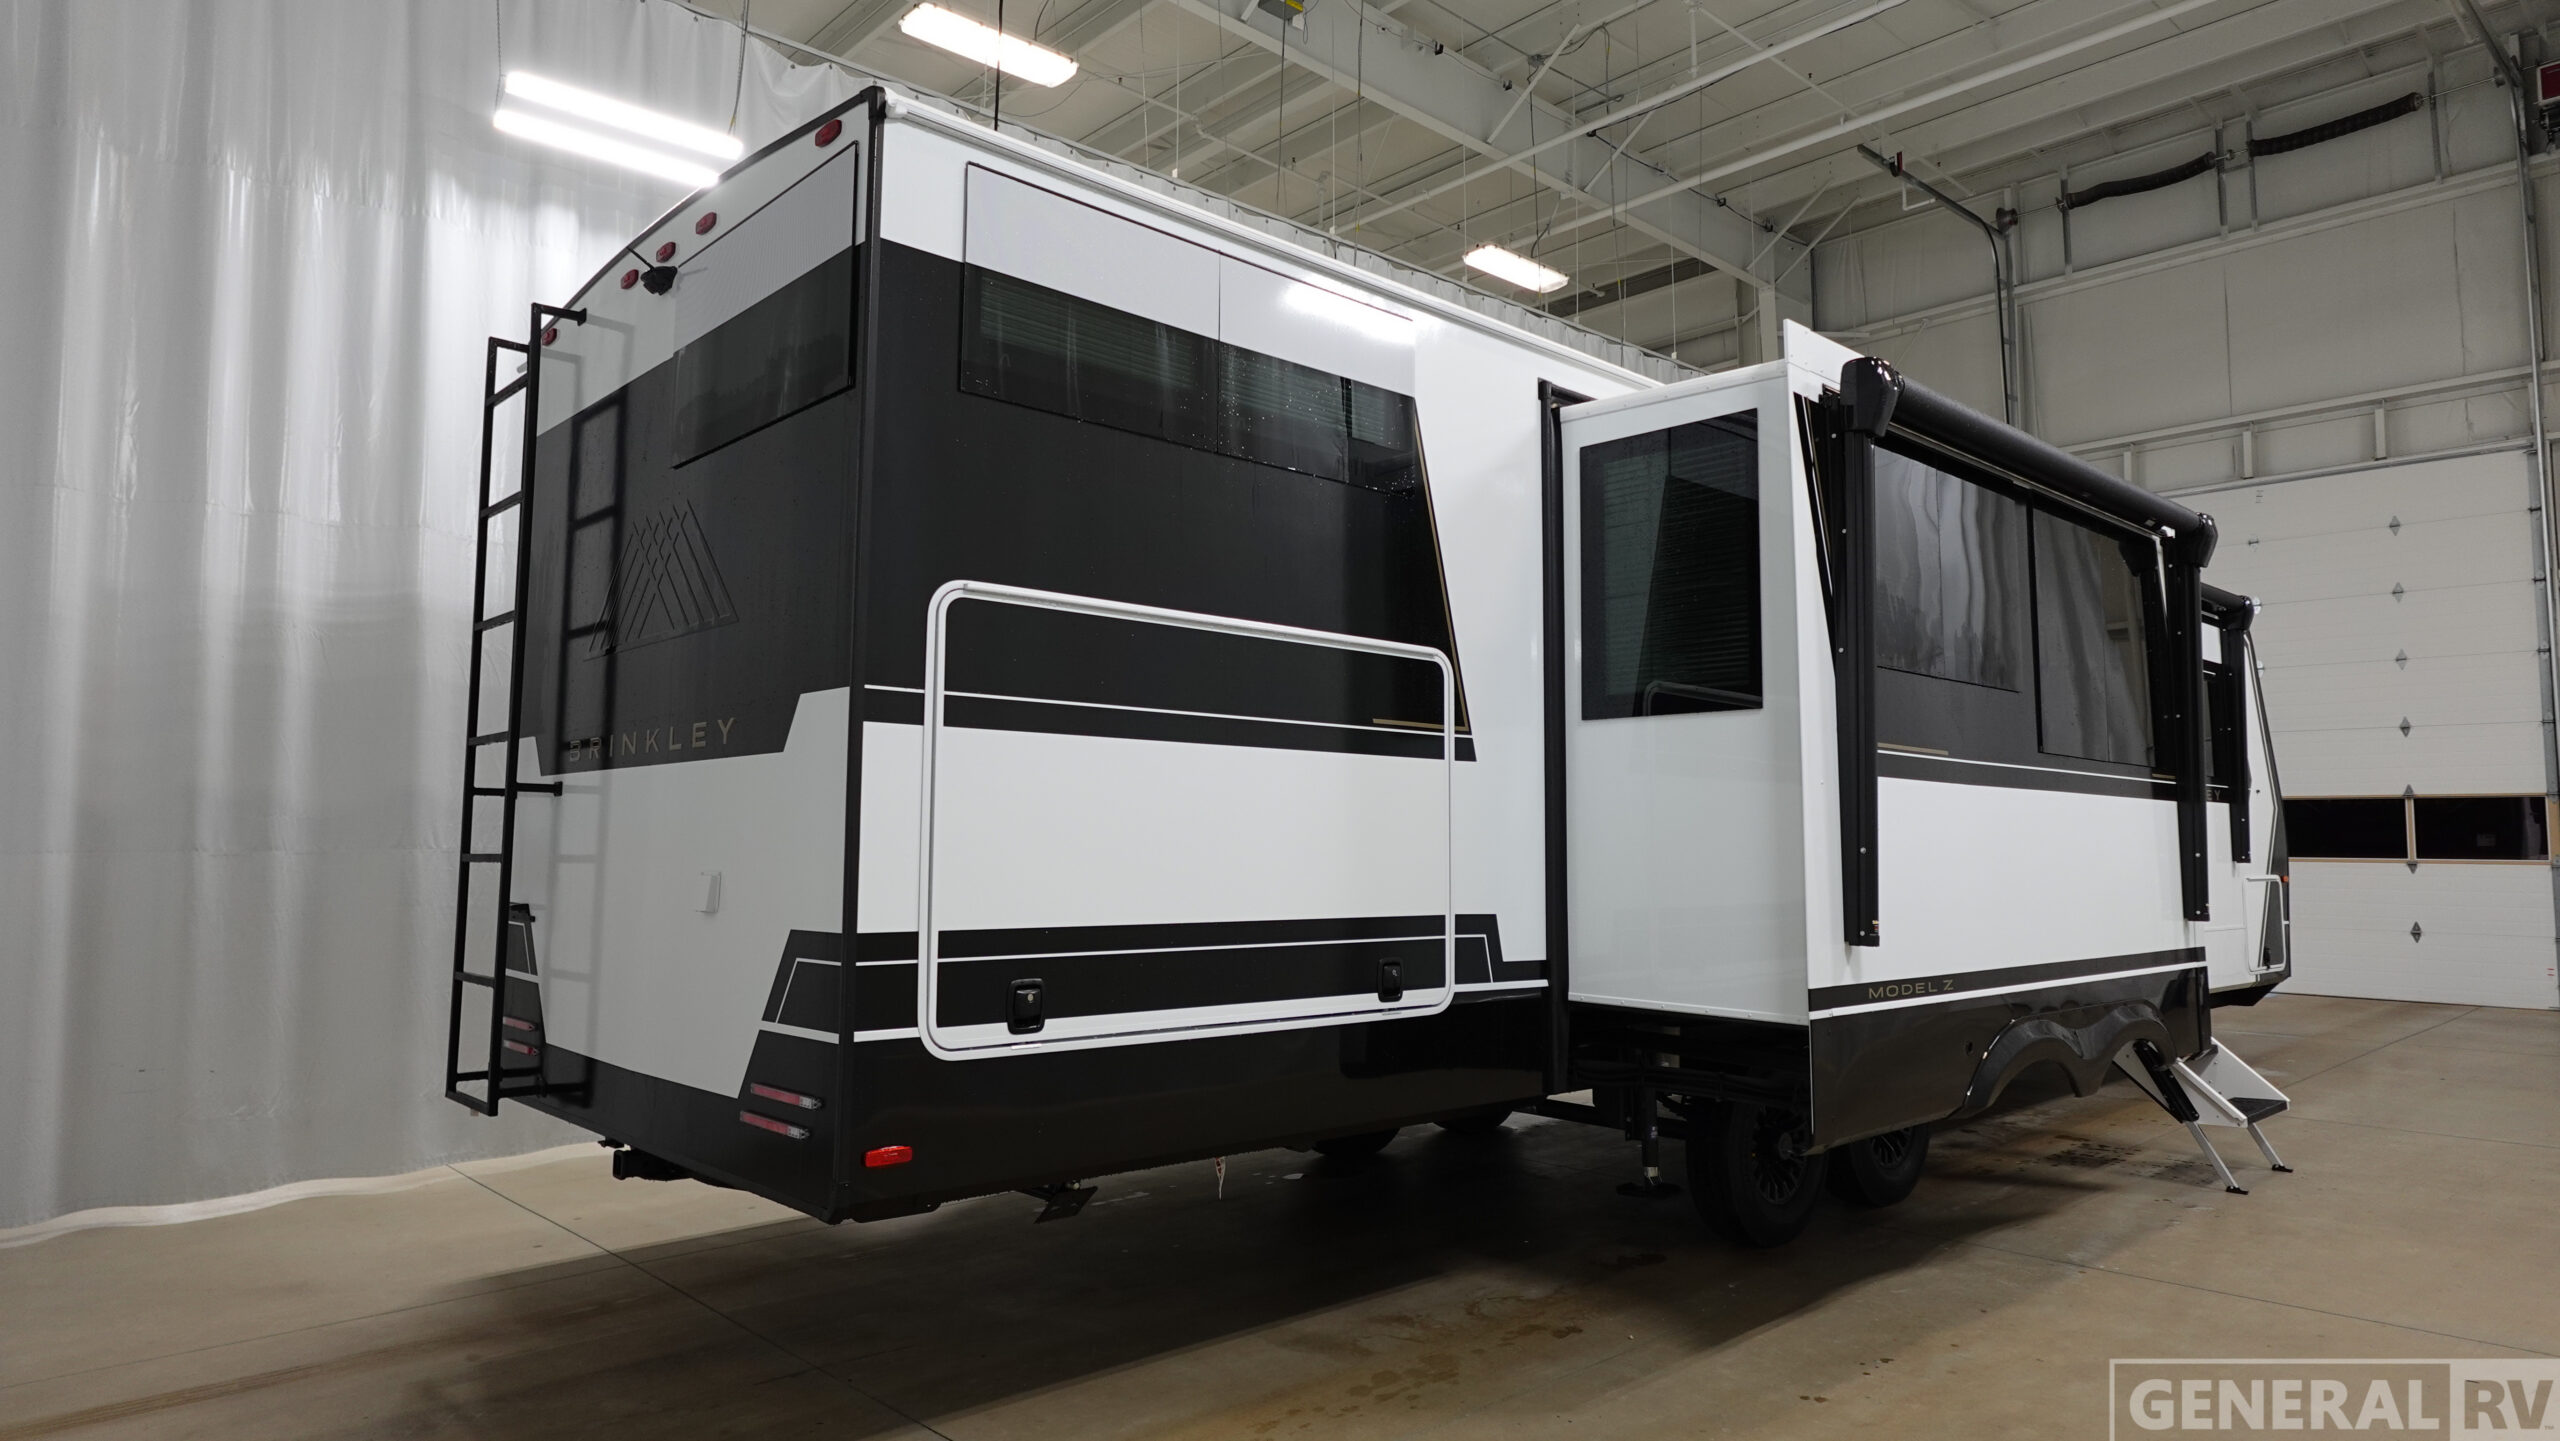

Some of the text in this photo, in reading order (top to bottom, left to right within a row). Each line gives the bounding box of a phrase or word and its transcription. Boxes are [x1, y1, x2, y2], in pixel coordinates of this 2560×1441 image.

[569, 717, 737, 762] BRINKLEY
[1868, 979, 1954, 999] MODEL Z
